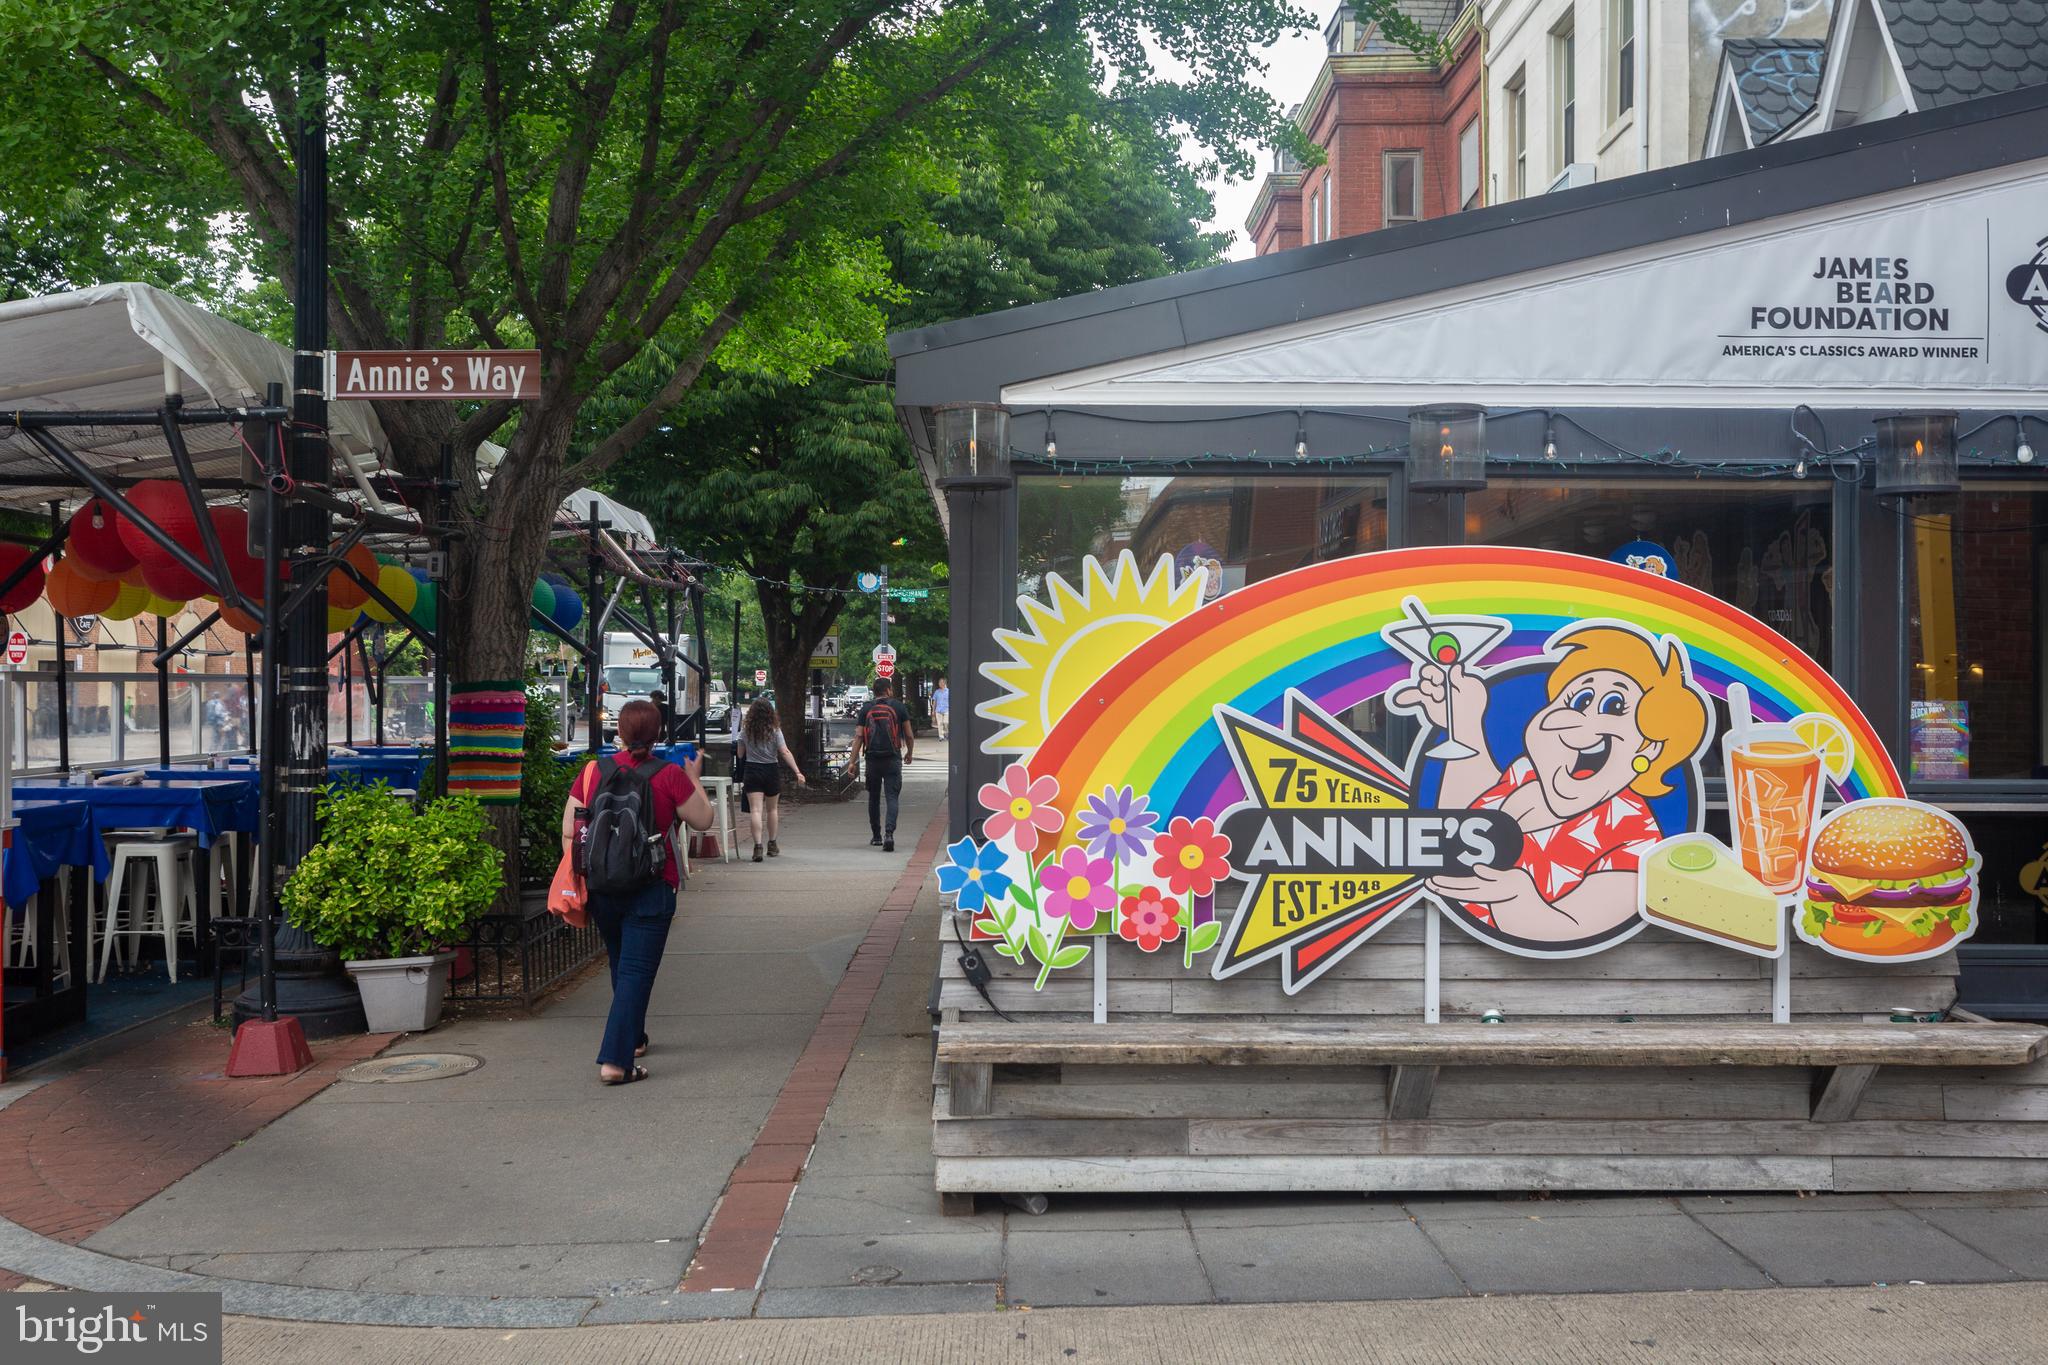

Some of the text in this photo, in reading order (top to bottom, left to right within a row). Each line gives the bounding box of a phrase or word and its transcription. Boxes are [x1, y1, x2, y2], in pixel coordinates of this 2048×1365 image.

[1813, 257, 1909, 280] JAMES
[1836, 281, 1935, 305] BEARD
[1751, 306, 1949, 331] FOUNDATION
[1722, 344, 1979, 358] AMERICA'S CLASSICS AWARD WINNER
[346, 356, 526, 399] Annie's Way
[877, 664, 894, 672] STOP
[1268, 758, 1381, 804] 75 YEARS
[1244, 815, 1496, 867] ANNIE'S
